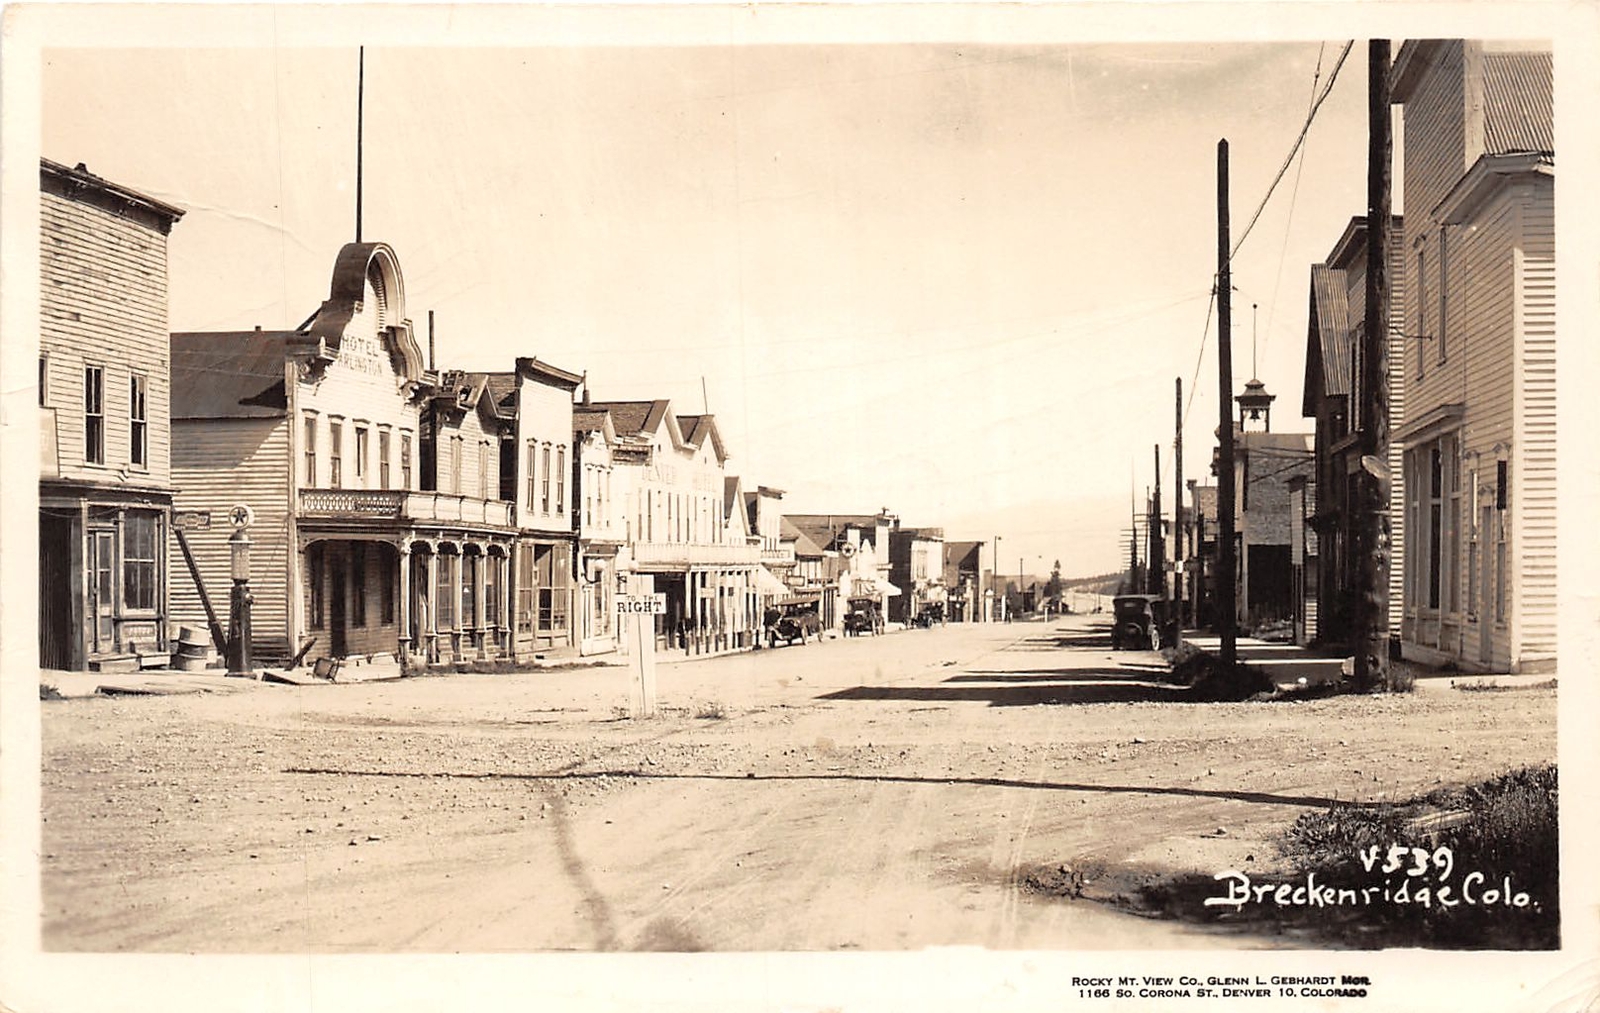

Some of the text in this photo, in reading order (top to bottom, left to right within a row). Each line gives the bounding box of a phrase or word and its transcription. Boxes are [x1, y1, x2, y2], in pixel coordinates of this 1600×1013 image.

[342, 335, 379, 357] HOTEL
[338, 353, 383, 376] ARLINGTON
[643, 594, 658, 602] THE
[616, 601, 662, 613] RIGHT
